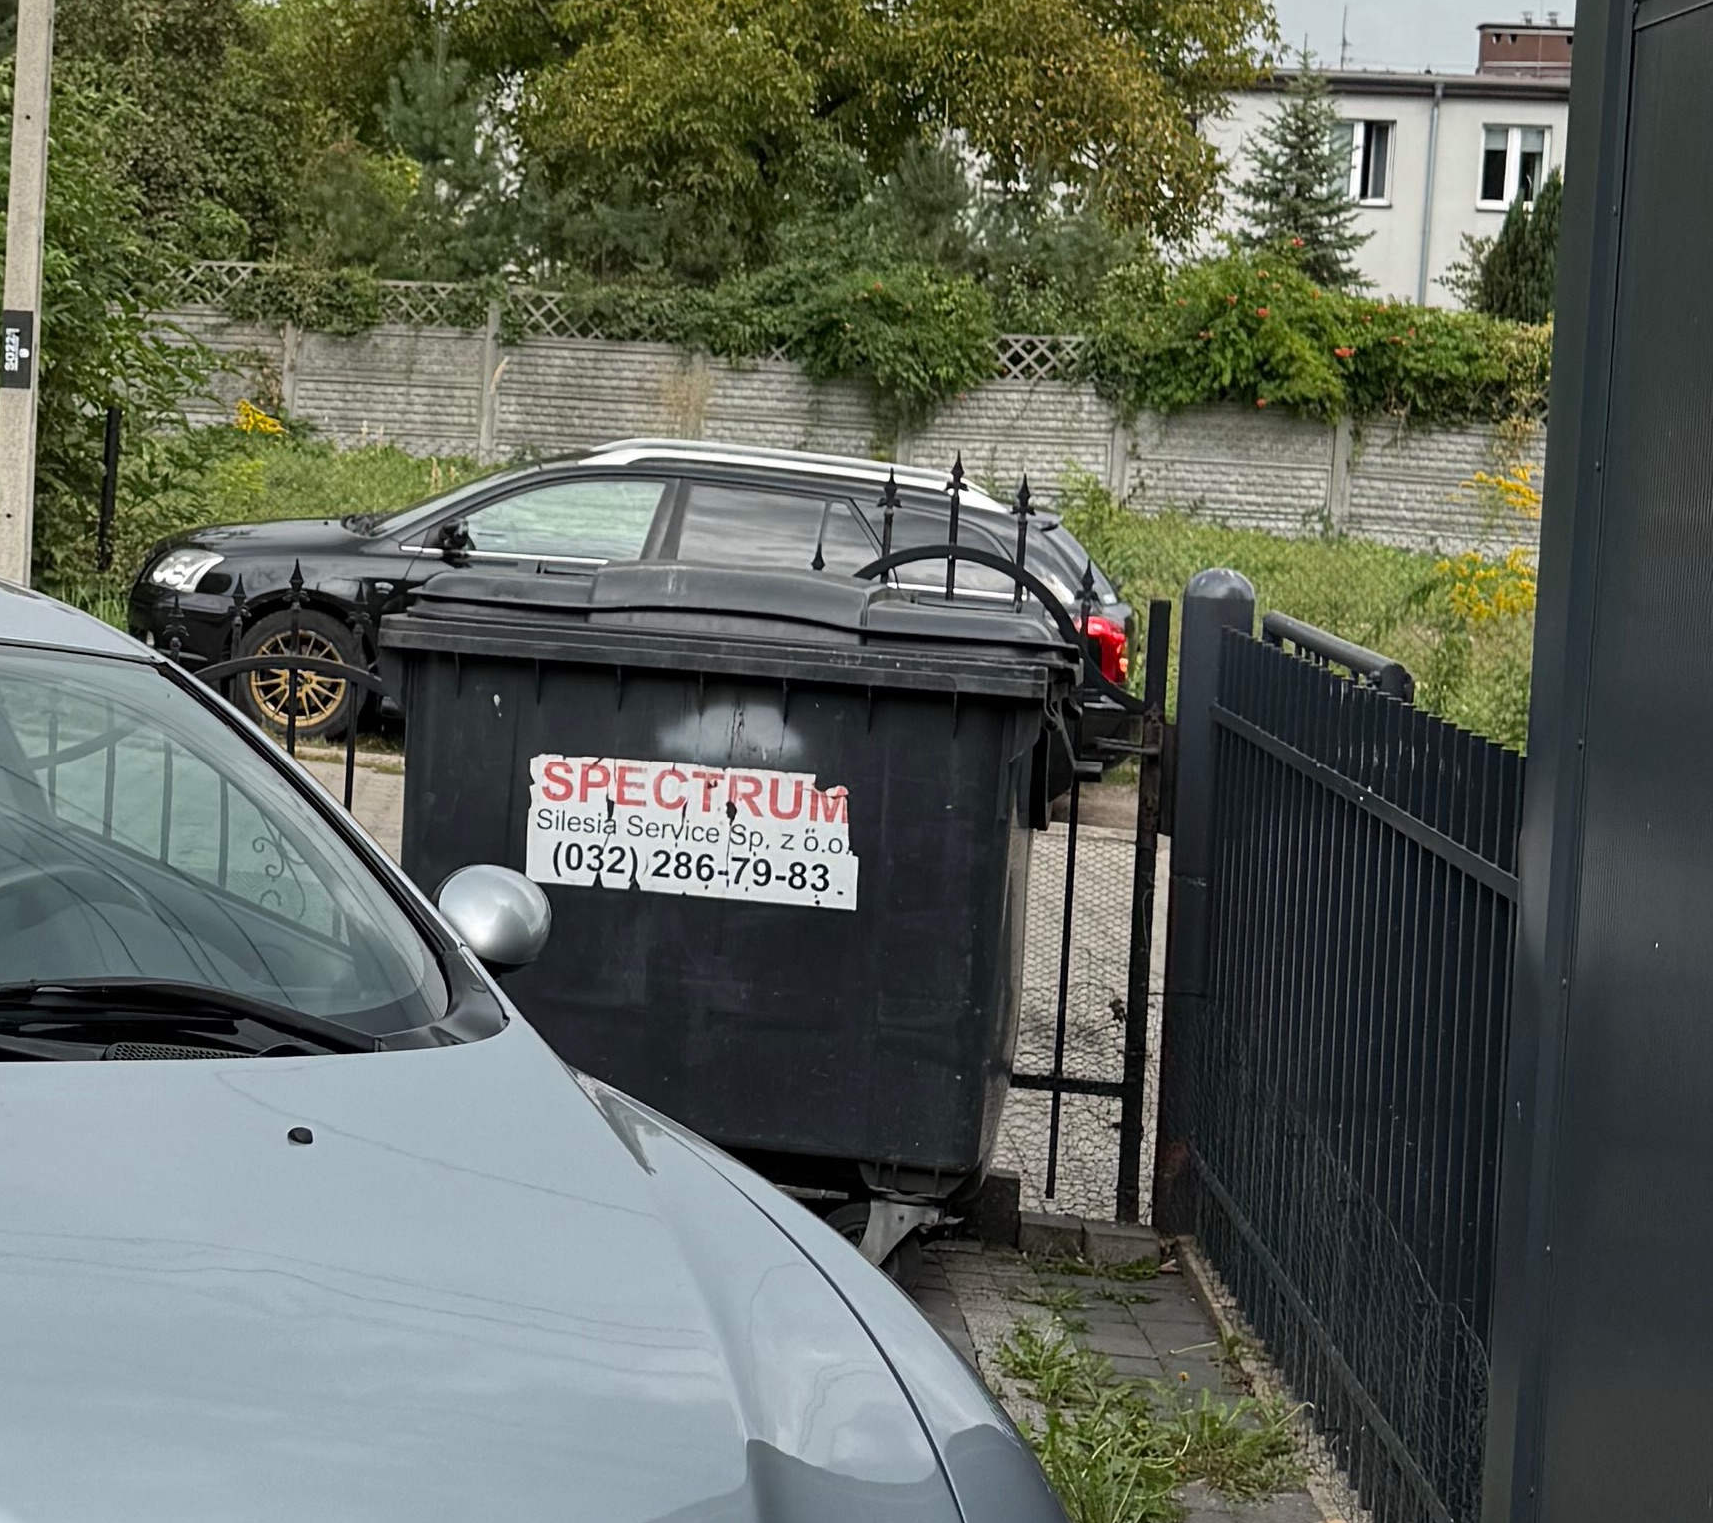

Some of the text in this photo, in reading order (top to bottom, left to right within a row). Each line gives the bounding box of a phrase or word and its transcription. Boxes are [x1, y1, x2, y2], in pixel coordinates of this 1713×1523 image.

[542, 761, 848, 824] SPECTRUM
[536, 808, 617, 836] Silesia
[626, 814, 720, 844] Service
[780, 833, 795, 850] z
[552, 840, 830, 892] (032) 286-79-83
